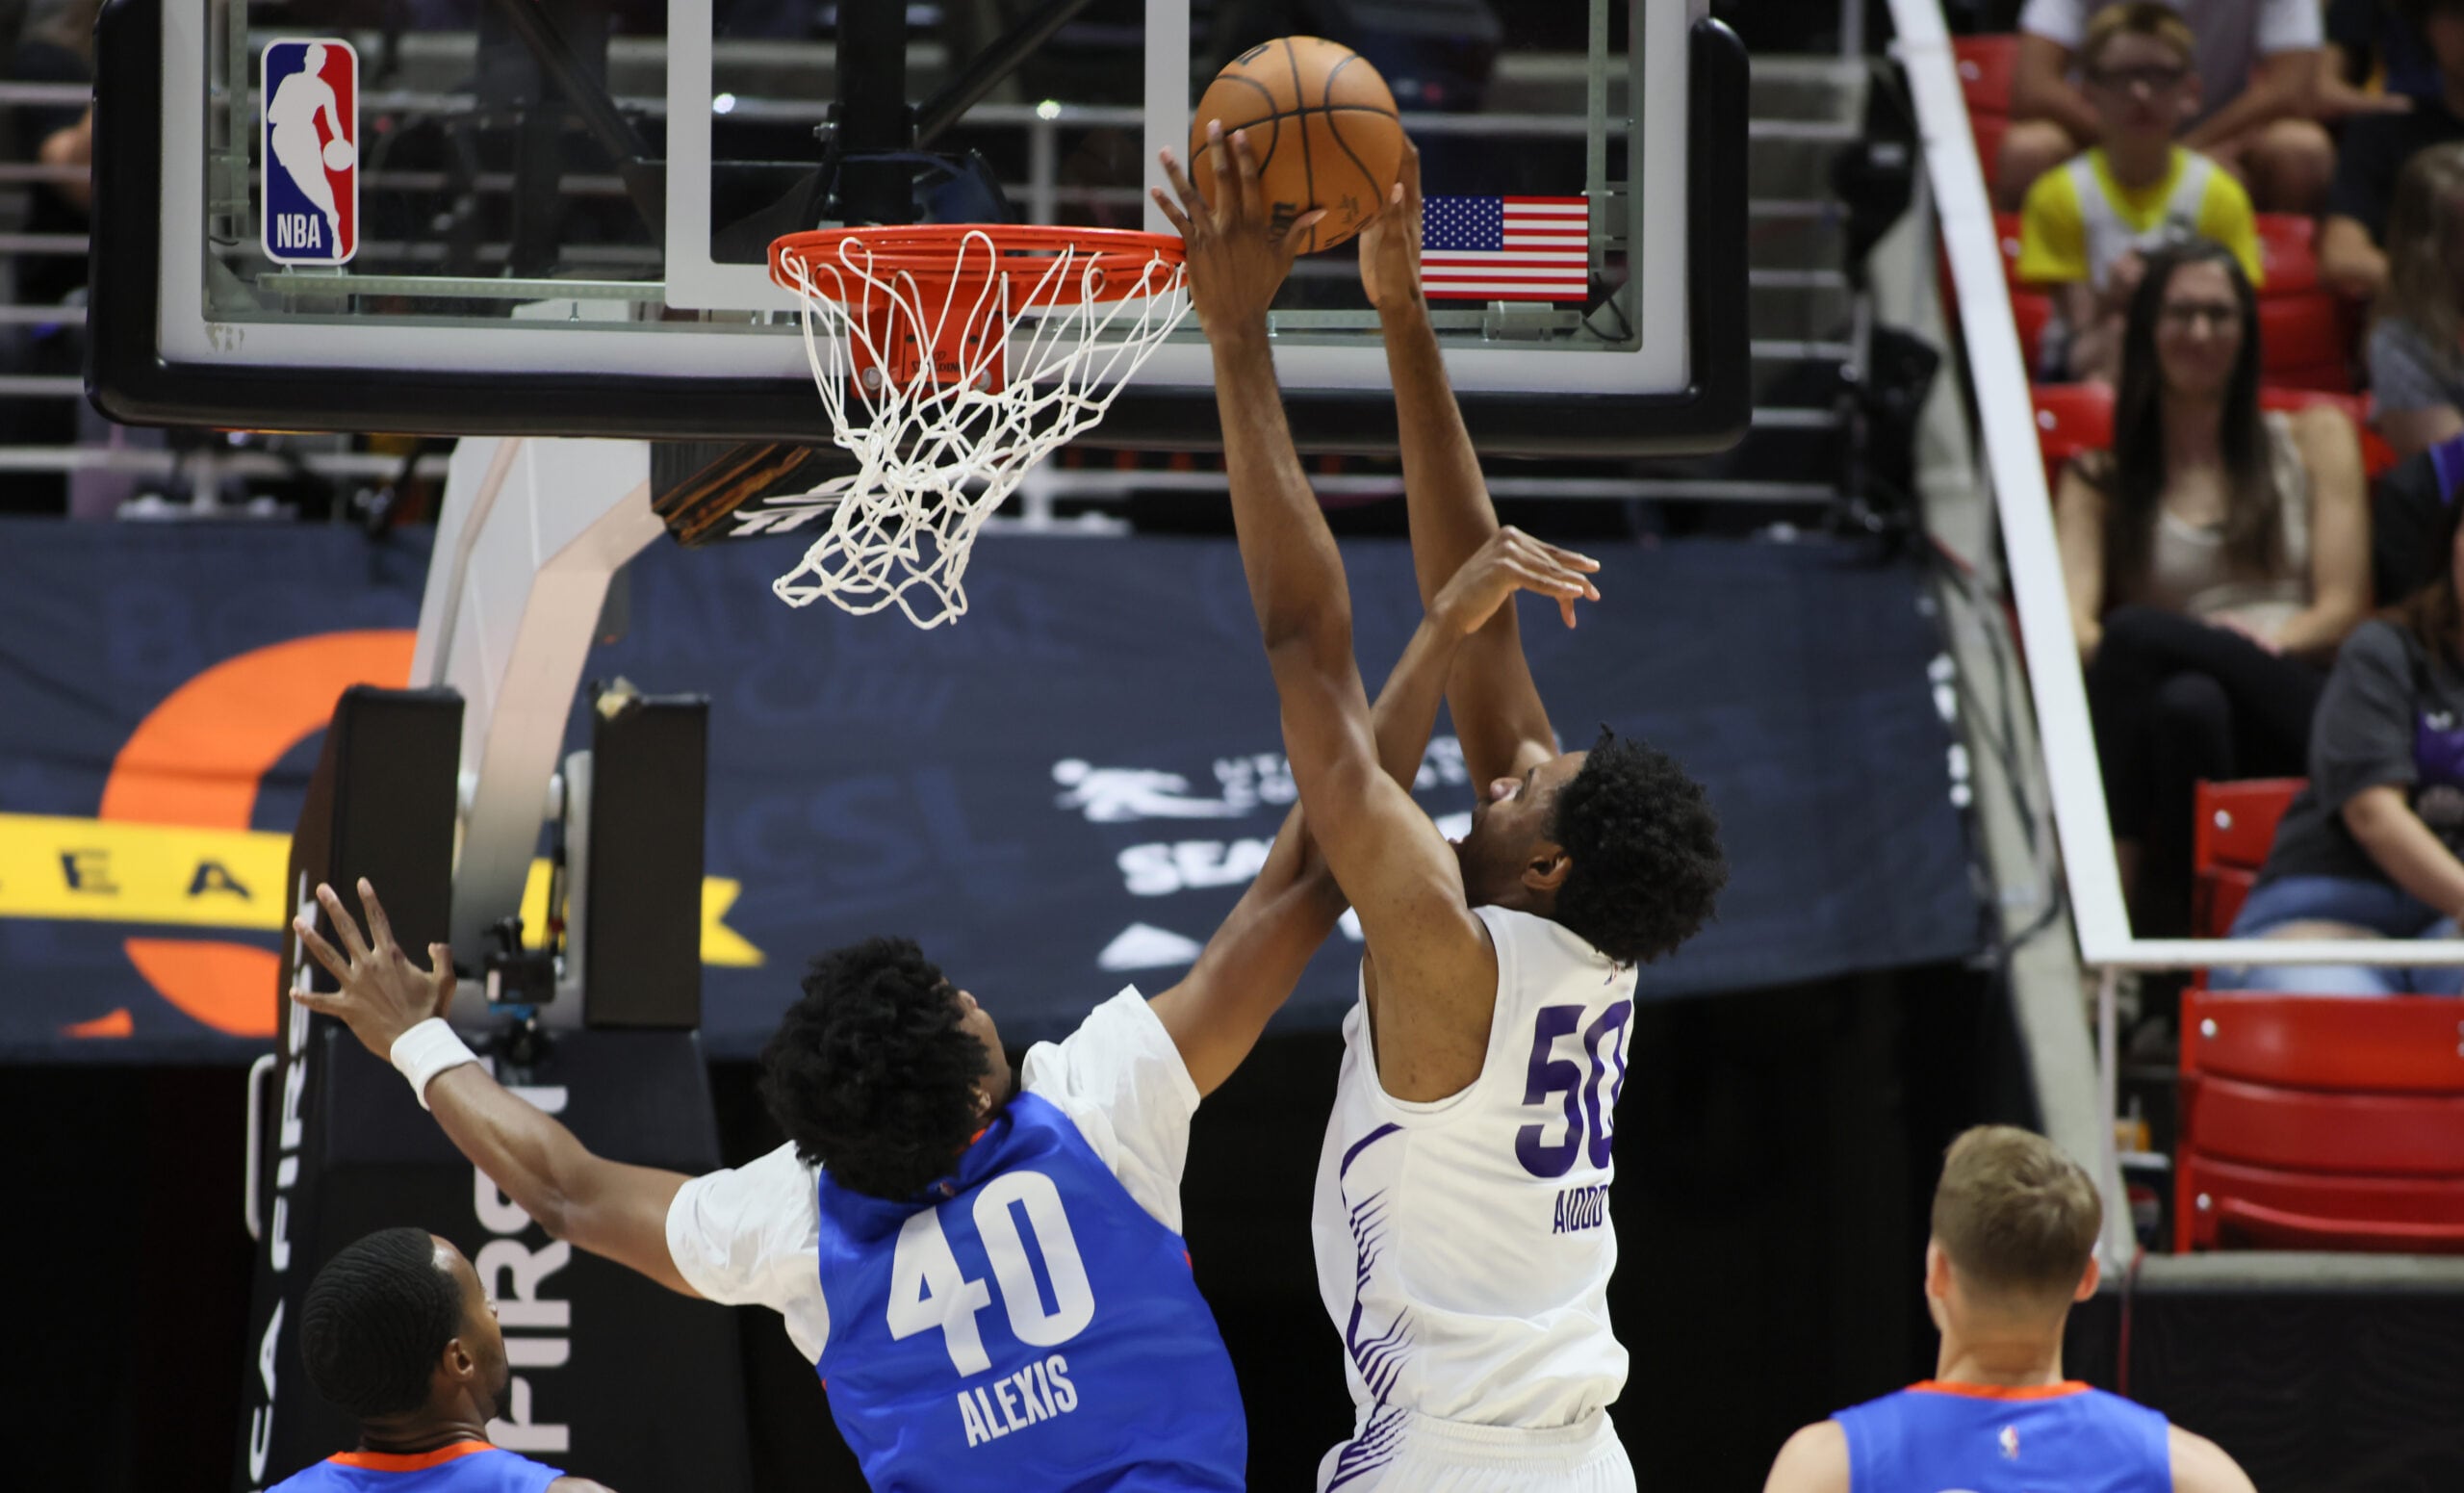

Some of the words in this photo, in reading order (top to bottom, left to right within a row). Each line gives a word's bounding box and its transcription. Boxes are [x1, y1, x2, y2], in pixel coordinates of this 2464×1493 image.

[277, 214, 321, 248] NBA
[1515, 1000, 1631, 1178] 50
[886, 1171, 1094, 1377] 40
[957, 1354, 1078, 1448] ALEXIS
